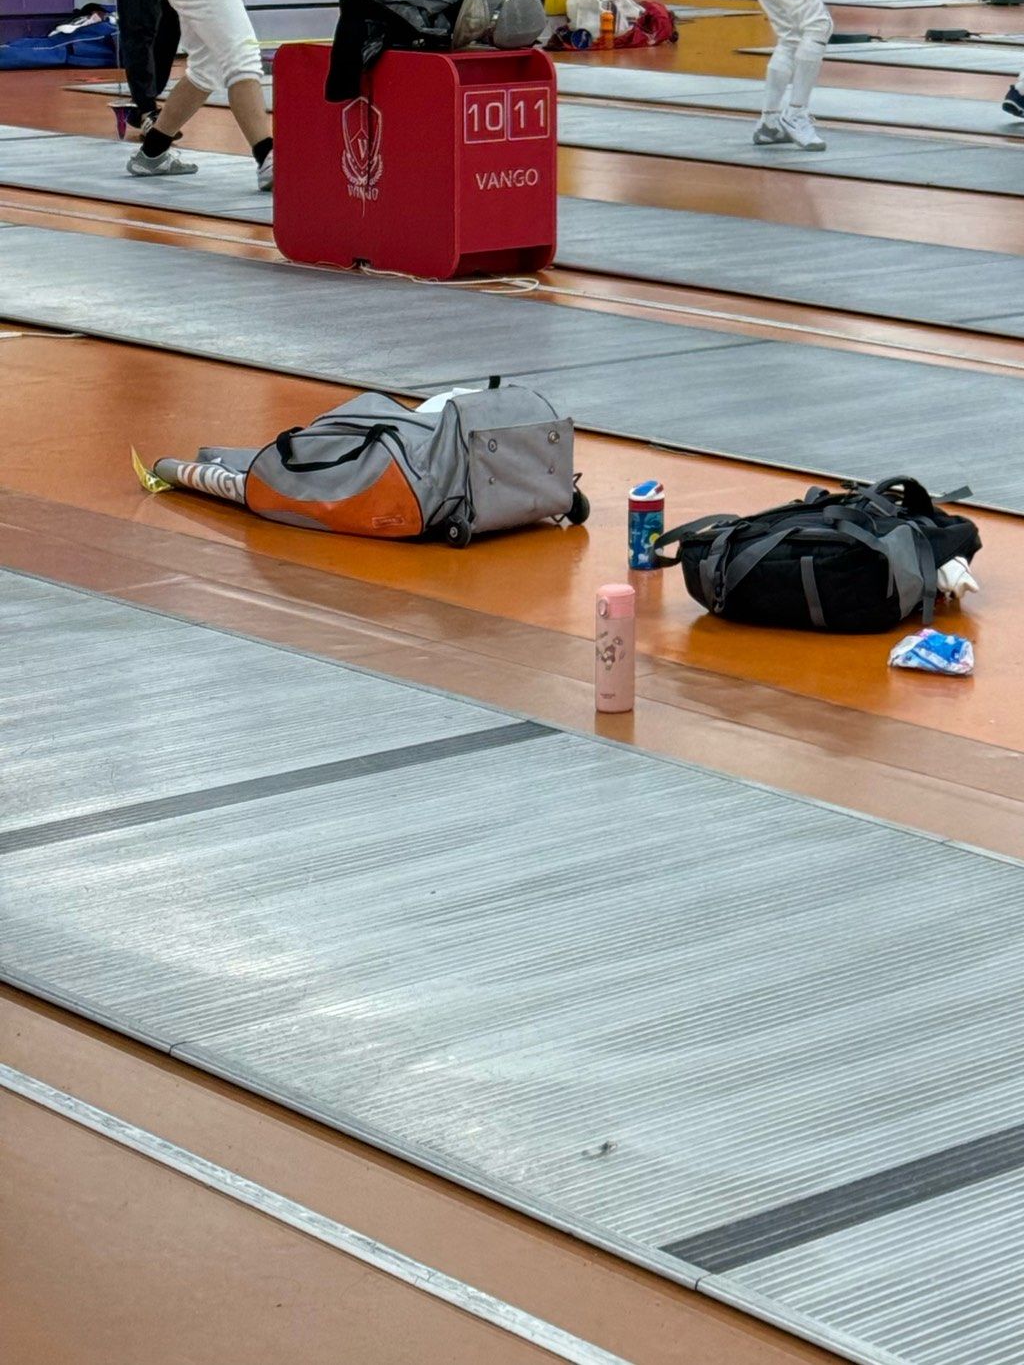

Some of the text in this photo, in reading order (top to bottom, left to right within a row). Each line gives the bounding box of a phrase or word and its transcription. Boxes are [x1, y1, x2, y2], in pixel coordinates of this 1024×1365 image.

[467, 98, 546, 133] 10 11
[475, 168, 539, 191] VANGO
